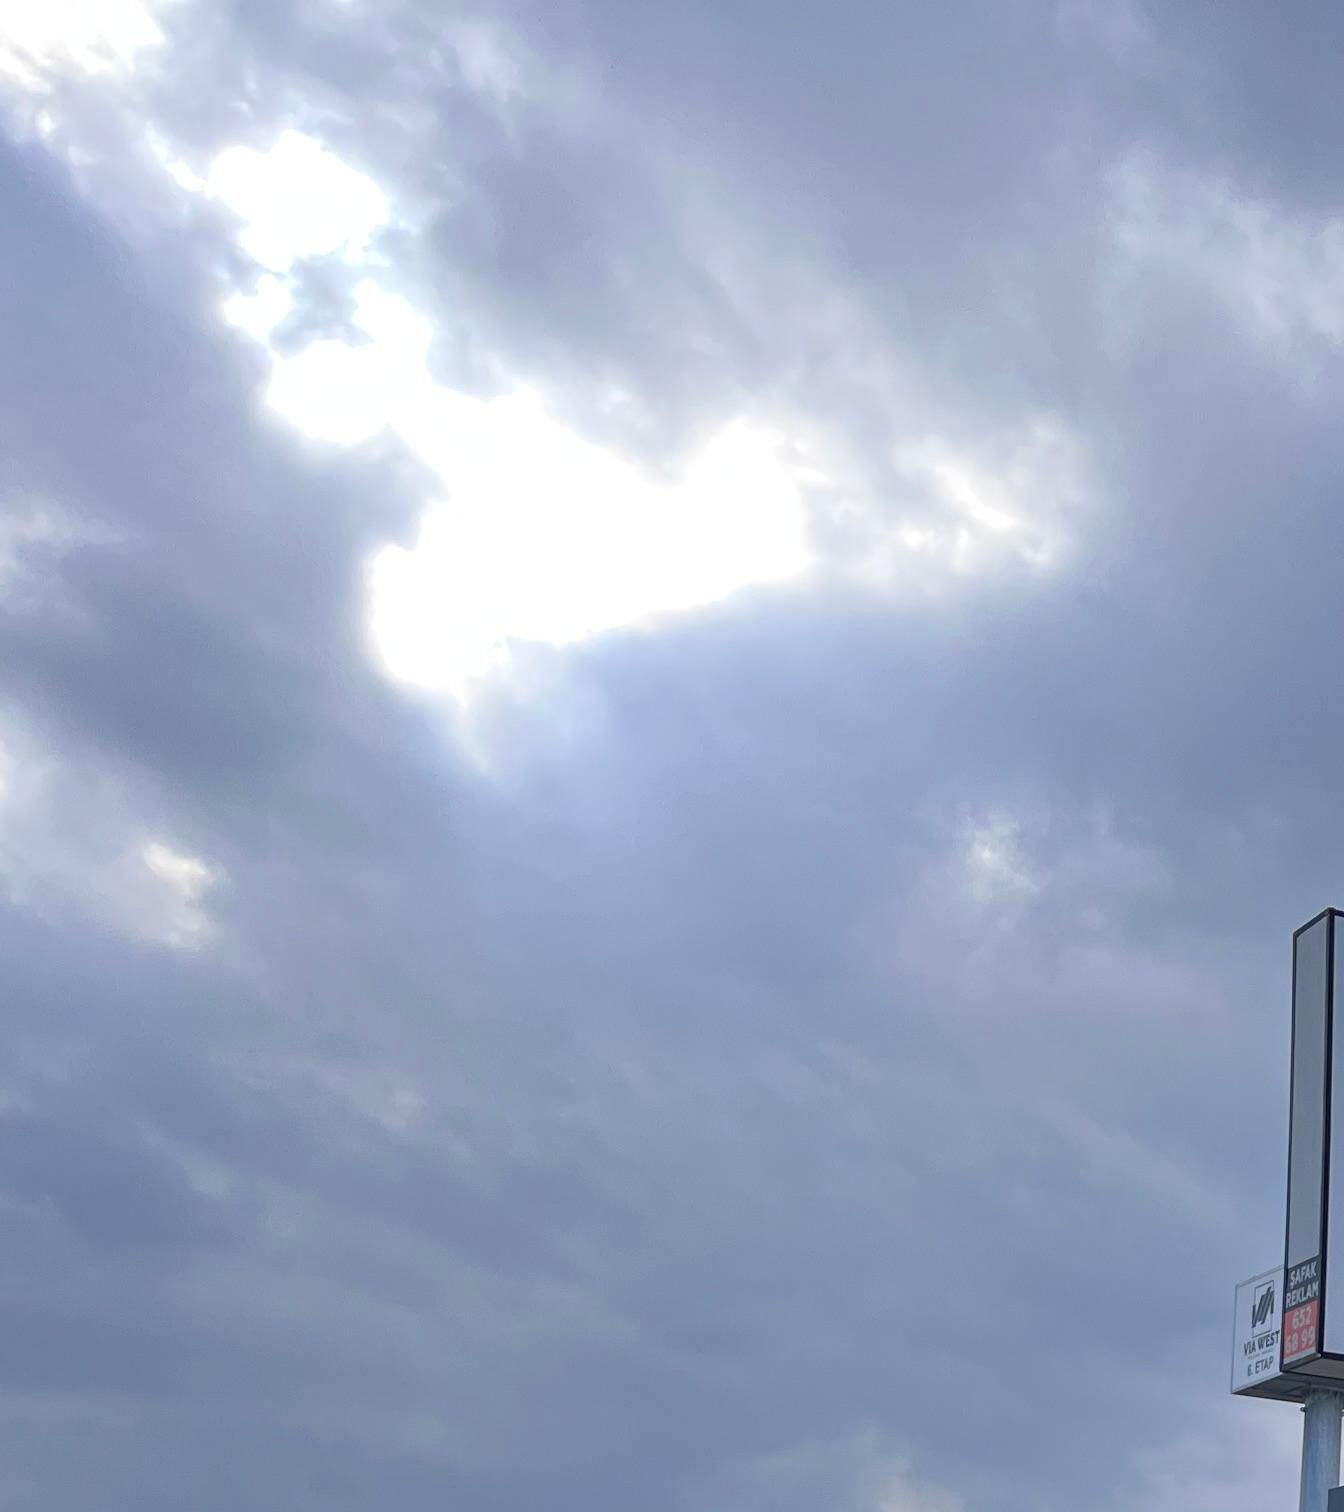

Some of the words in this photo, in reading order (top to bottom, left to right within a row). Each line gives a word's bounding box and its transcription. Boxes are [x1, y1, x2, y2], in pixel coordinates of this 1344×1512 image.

[1290, 1261, 1317, 1288] ŞAFAK
[1285, 1281, 1319, 1308] REKLAM
[1258, 1330, 1280, 1350] WEST
[1255, 1356, 1274, 1374] ETAP
